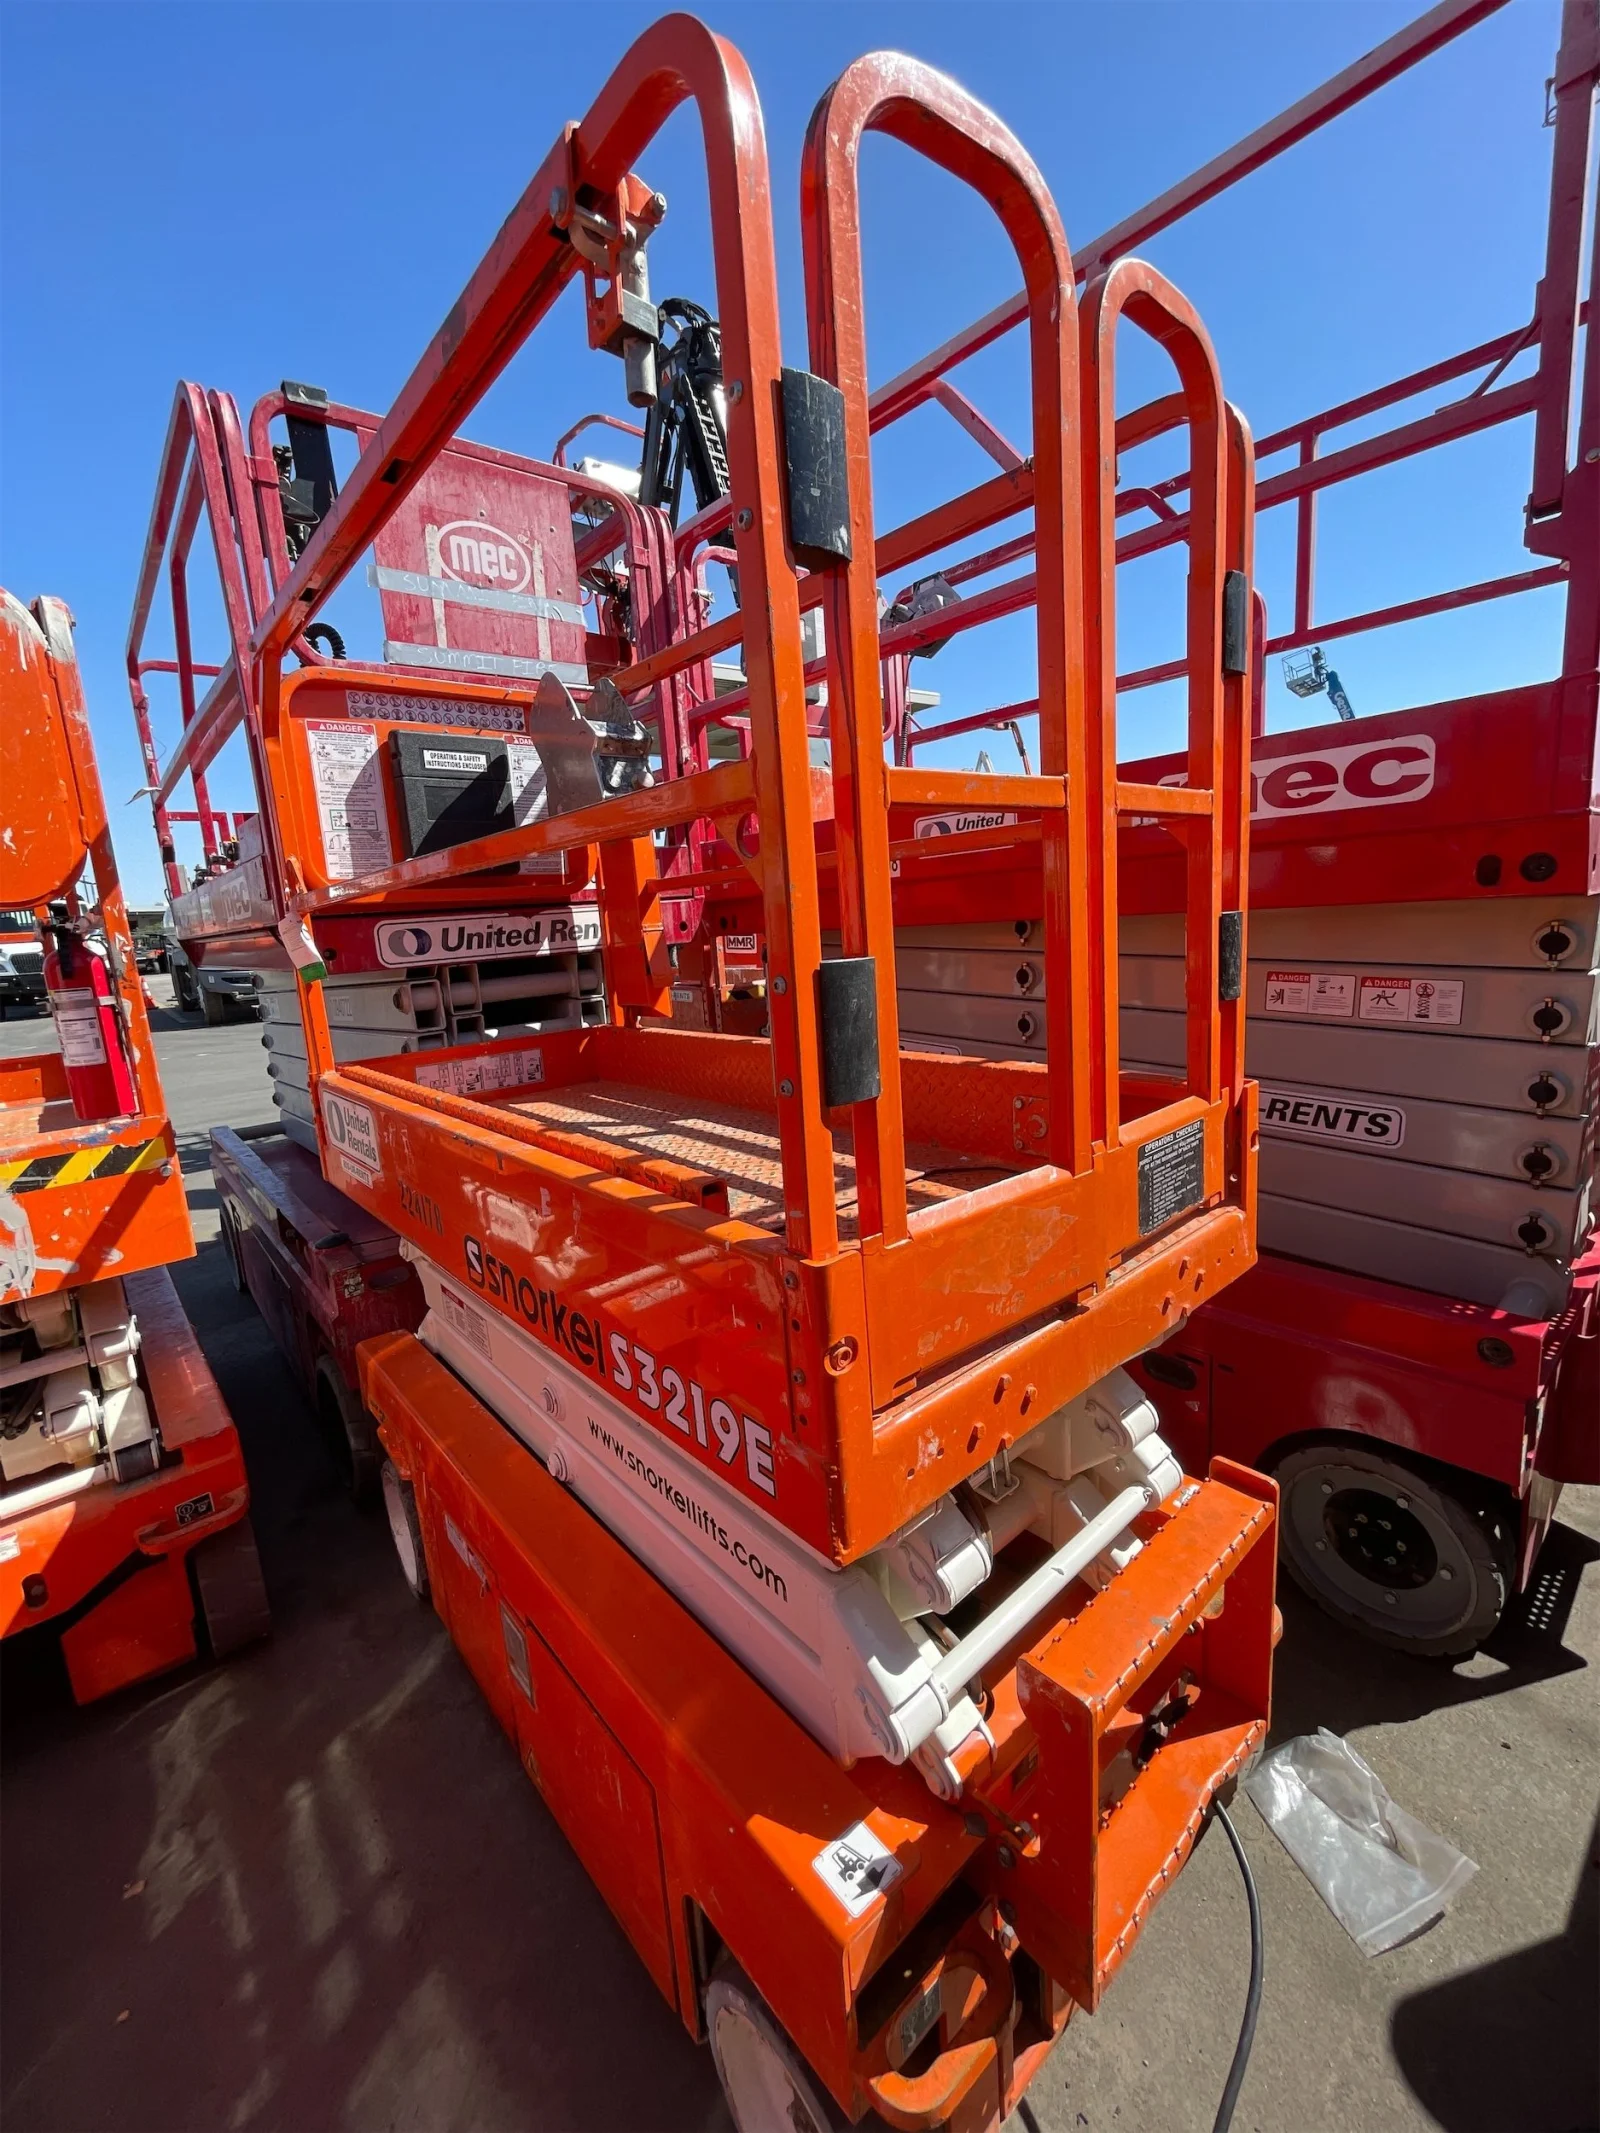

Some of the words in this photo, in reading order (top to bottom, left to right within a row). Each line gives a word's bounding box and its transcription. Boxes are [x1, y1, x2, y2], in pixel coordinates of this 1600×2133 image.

[450, 534, 518, 581] mec
[416, 647, 501, 670] SUMMIT
[326, 723, 365, 733] DANGER
[426, 760, 461, 769] INSTRUCTIONS
[463, 755, 481, 763] SAFETY
[955, 812, 1005, 832] United
[441, 918, 541, 952] United
[728, 936, 754, 948] MMR
[1278, 974, 1310, 982] DANGER
[1374, 979, 1410, 988] DANGER
[343, 1107, 370, 1137] United
[1175, 1121, 1201, 1139] CHECKLIST
[347, 1132, 377, 1162] Rentals
[485, 1252, 607, 1377] snorkel
[608, 1330, 778, 1499] S3219E
[586, 1415, 788, 1603] www.snorkellifts.com
